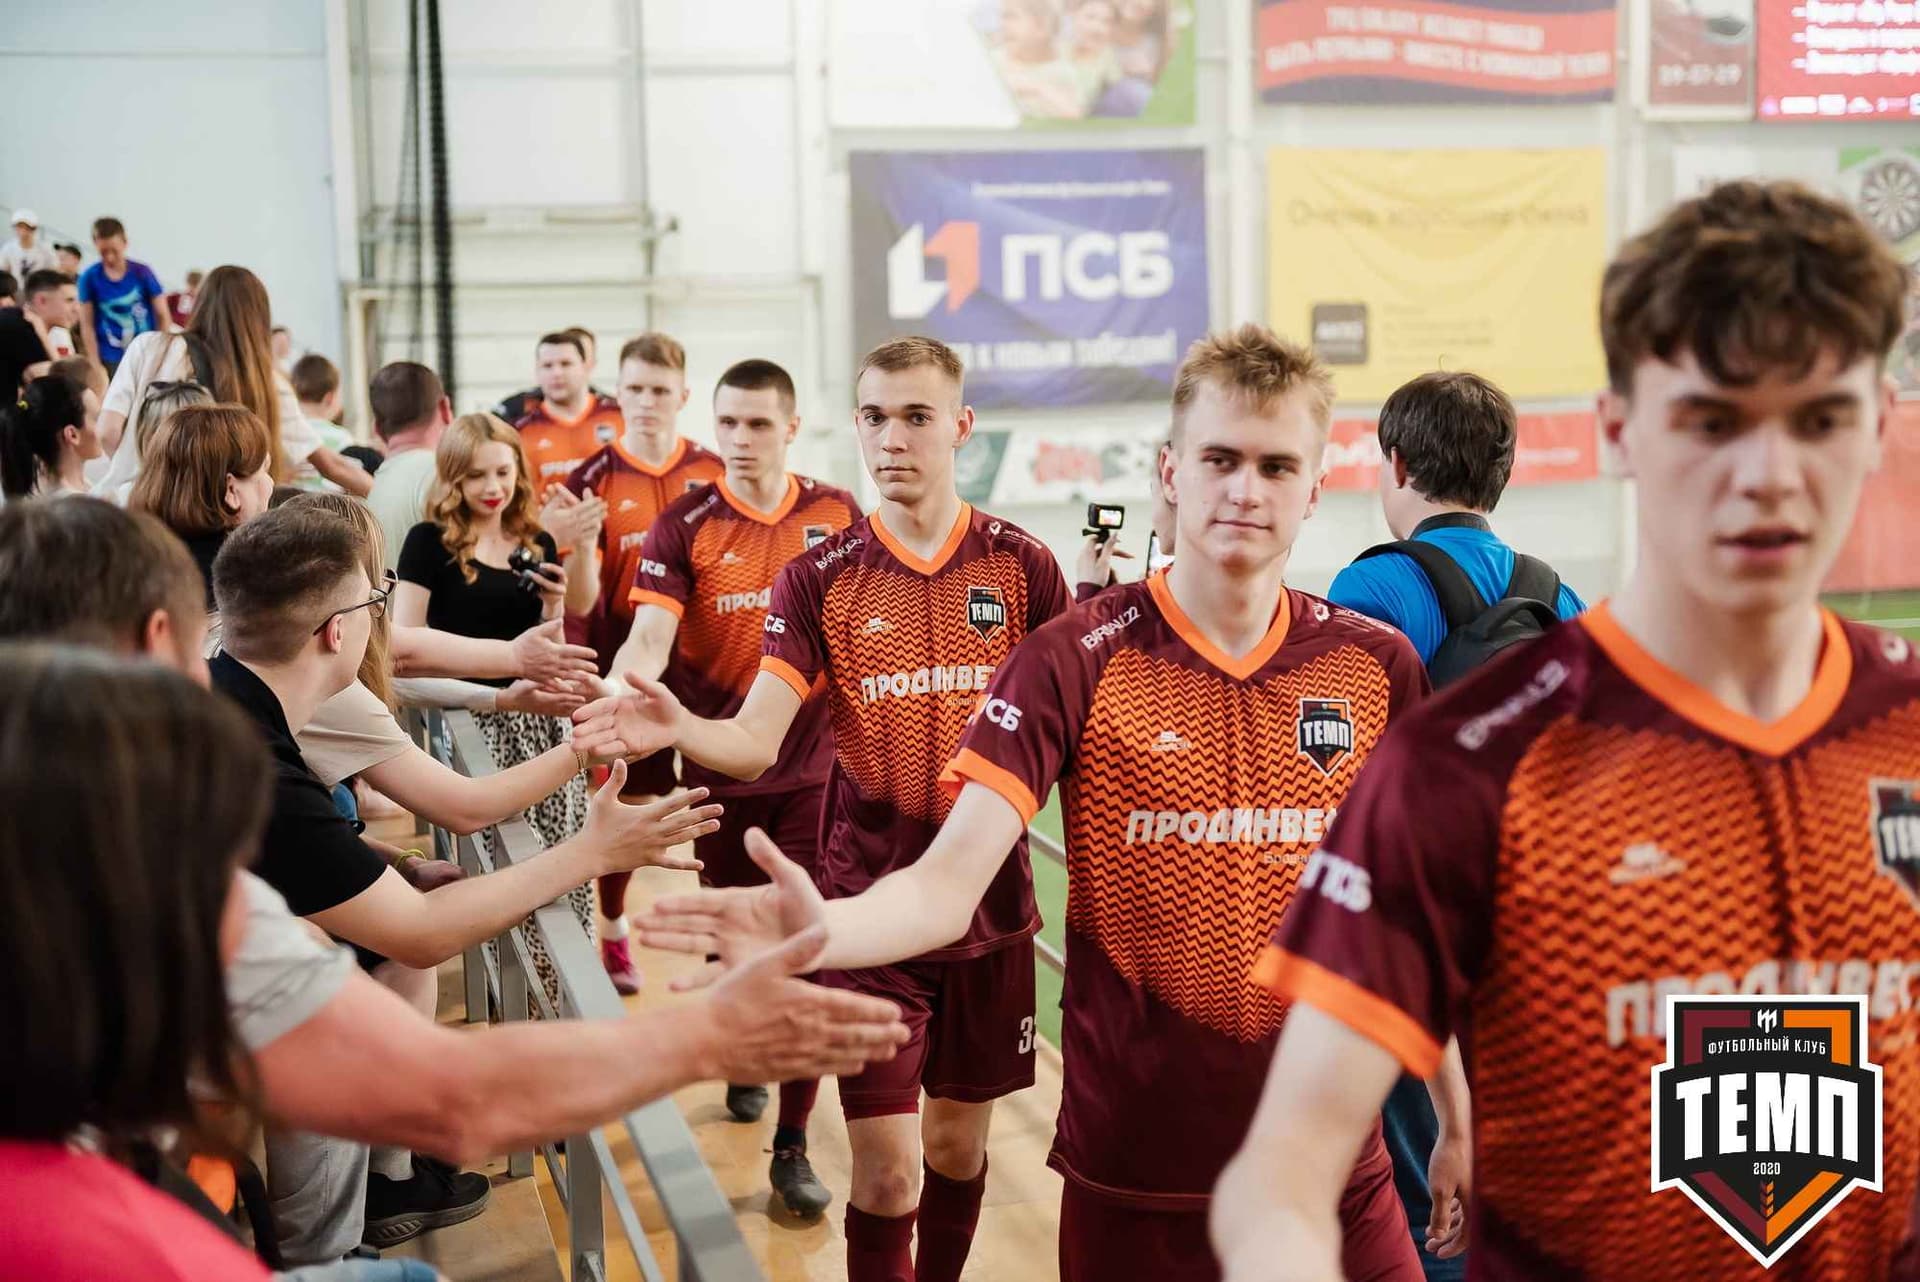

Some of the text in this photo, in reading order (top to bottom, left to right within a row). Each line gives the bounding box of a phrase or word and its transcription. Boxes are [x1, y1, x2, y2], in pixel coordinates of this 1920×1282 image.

[1002, 231, 1174, 301] ПСБ
[970, 603, 1002, 623] ТЕМП
[1302, 720, 1350, 748] ТЕМП
[1018, 1016, 1037, 1054] 3
